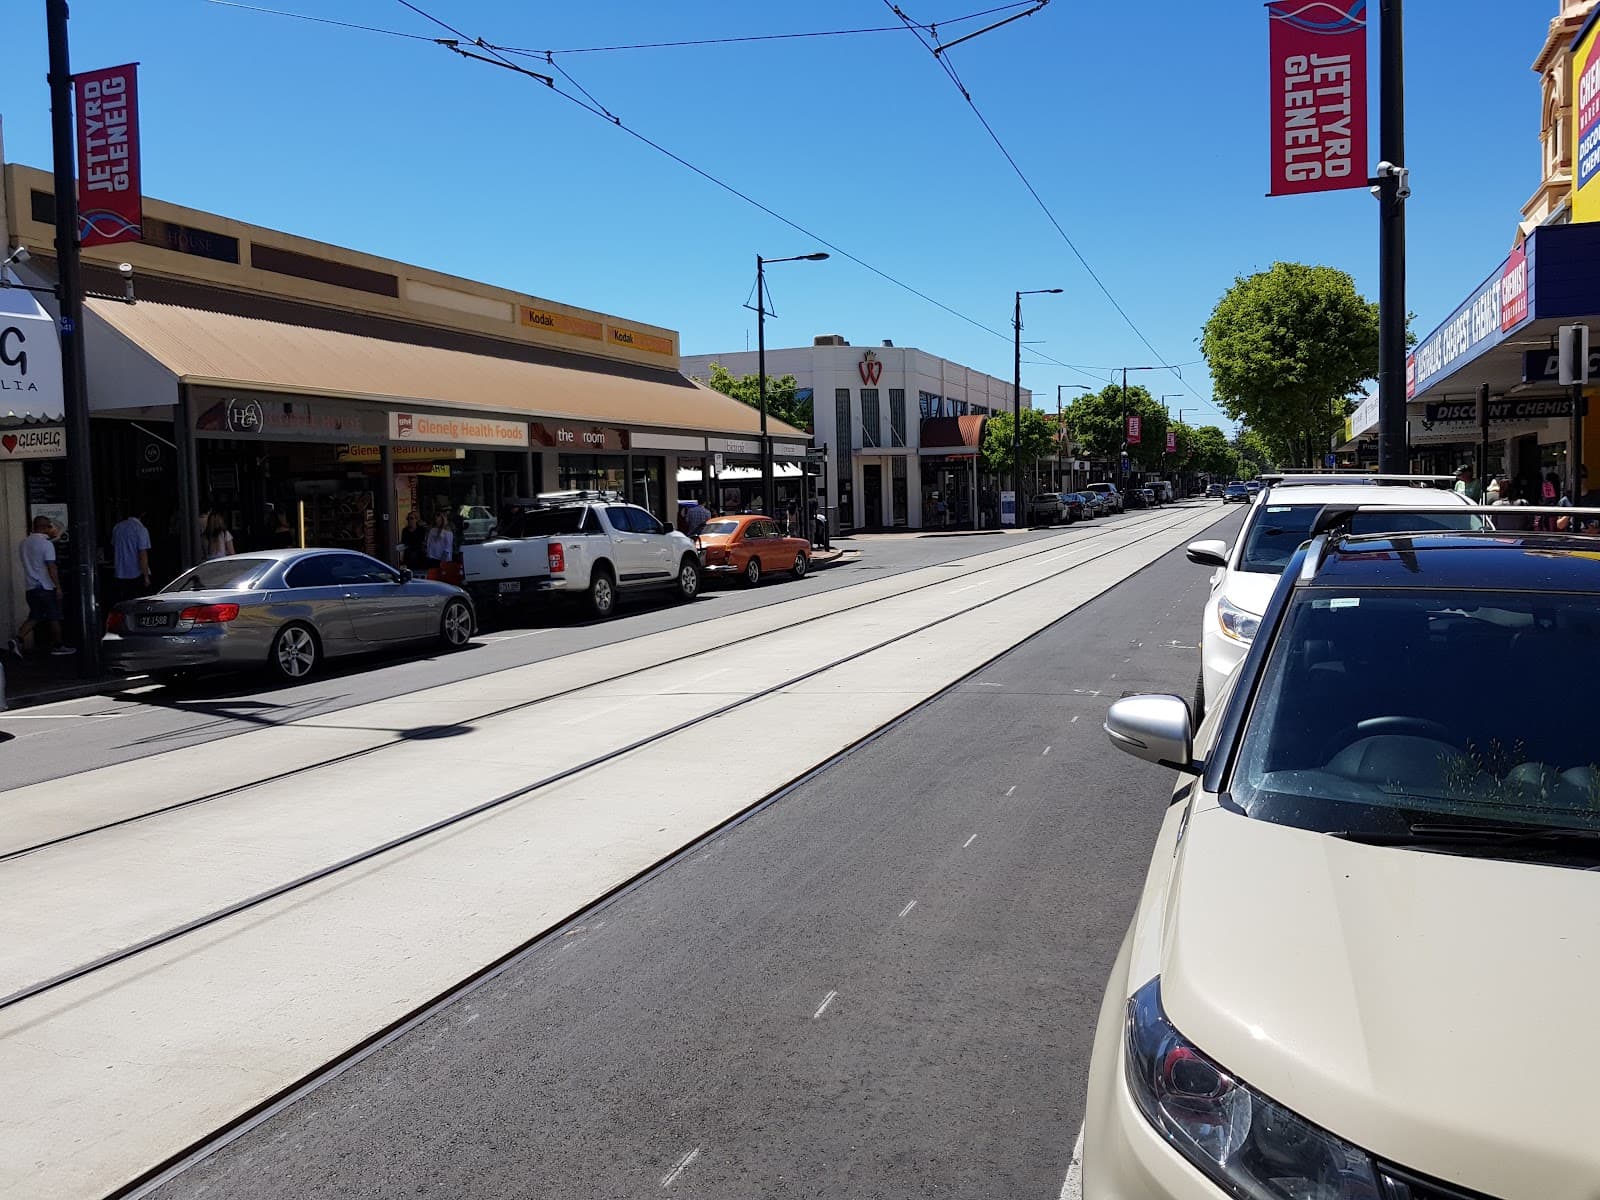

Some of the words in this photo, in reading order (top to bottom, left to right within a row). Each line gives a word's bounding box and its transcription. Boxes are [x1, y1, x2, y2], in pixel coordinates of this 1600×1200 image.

[1284, 55, 1322, 182] GLENELG
[102, 75, 130, 192] GLENELG
[1579, 124, 1600, 161] DISCO
[1502, 260, 1526, 307] CHEMIST
[529, 311, 554, 328] Kodak
[1443, 309, 1470, 367] CHEAPEST
[1471, 279, 1501, 344] CHEMIST
[614, 329, 634, 344] Kodak
[858, 361, 883, 386] W
[19, 431, 61, 449] GLENELG
[418, 417, 458, 437] Glenelg
[461, 421, 494, 438] Health
[495, 425, 523, 440] Foods
[558, 428, 574, 442] the
[583, 431, 605, 444] room
